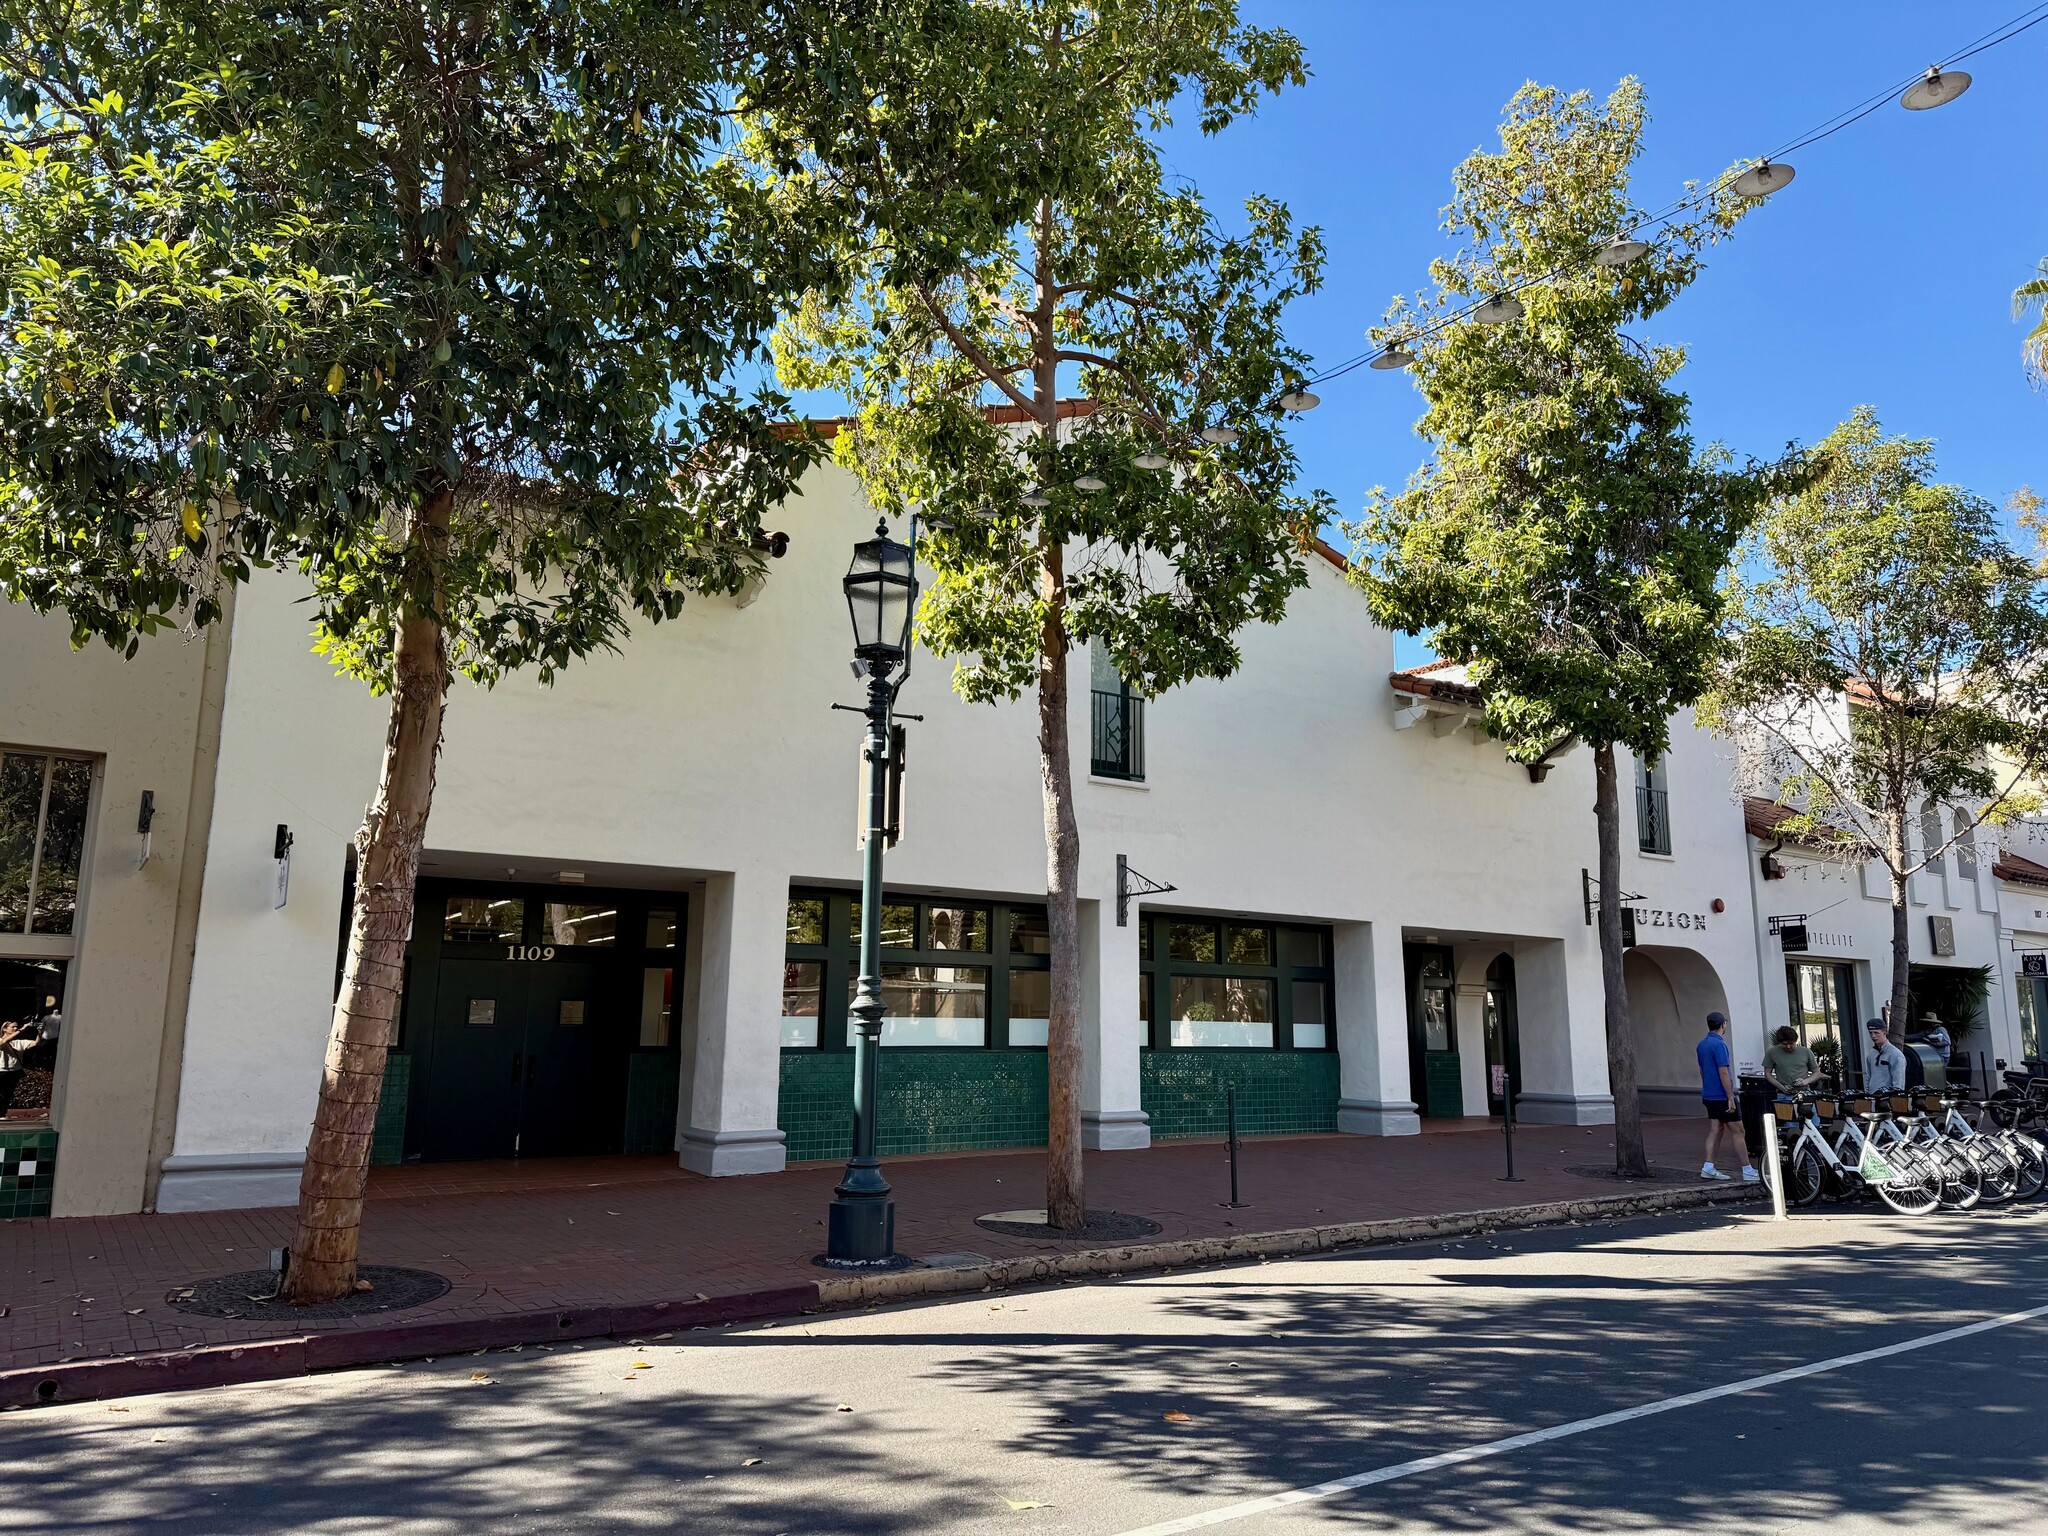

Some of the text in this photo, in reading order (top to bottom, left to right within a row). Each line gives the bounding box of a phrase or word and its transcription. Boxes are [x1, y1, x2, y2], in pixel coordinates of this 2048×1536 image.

[1635, 908, 1706, 931] UZION
[1807, 931, 1853, 947] ATELLITE
[506, 945, 555, 961] 1109
